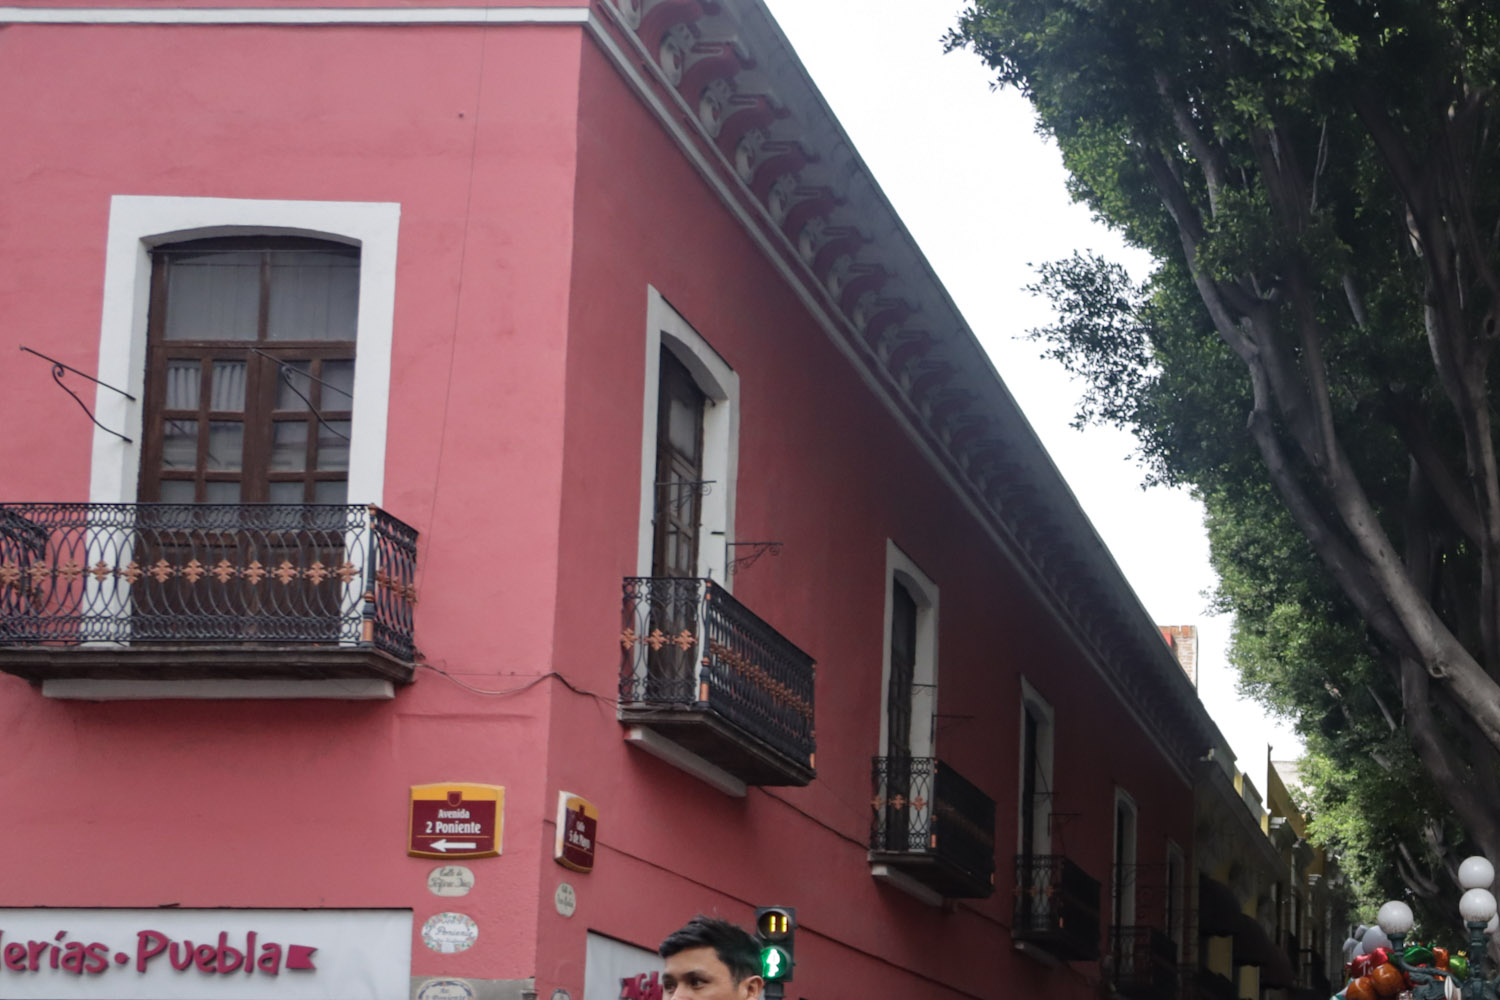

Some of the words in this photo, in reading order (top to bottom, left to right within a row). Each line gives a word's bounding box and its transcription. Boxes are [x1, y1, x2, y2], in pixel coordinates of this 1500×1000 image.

[438, 809, 470, 819] Avenida
[425, 821, 433, 834] 2
[435, 821, 481, 834] Poniente
[770, 915, 788, 933] 11
[136, 929, 283, 975] Puebla
